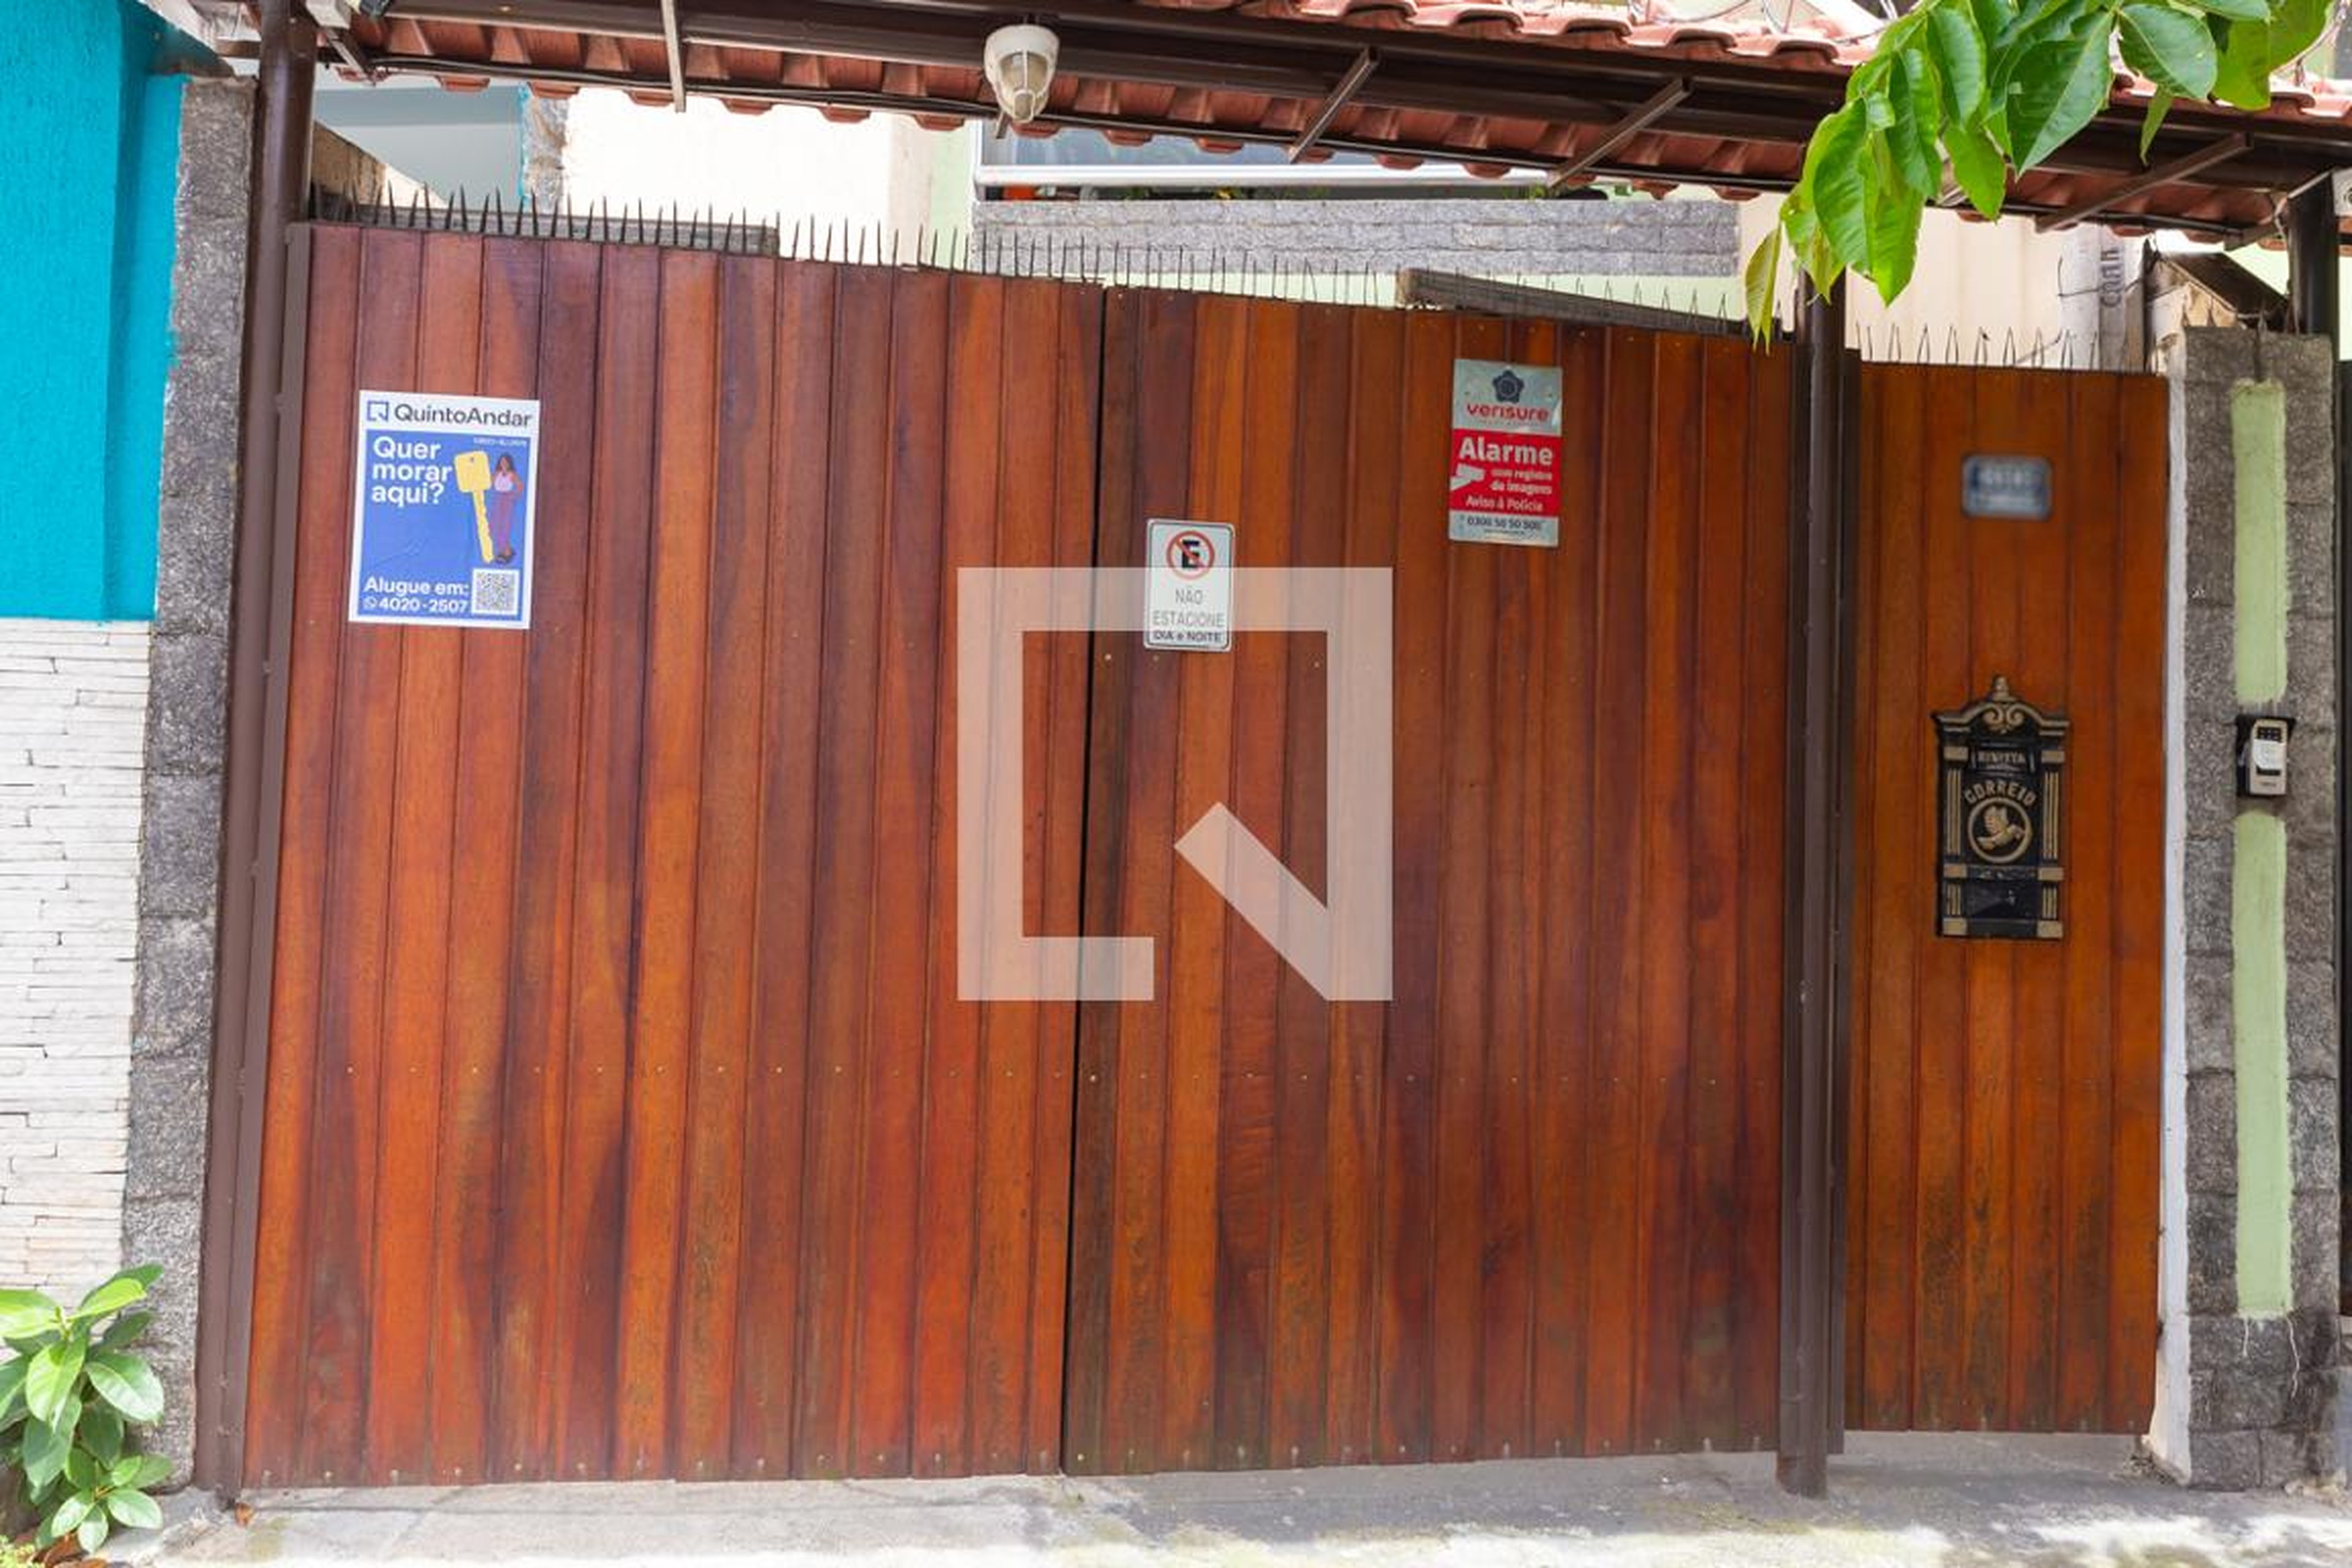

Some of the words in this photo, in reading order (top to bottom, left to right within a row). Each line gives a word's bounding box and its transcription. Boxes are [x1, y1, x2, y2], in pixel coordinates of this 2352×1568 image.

[394, 404, 532, 428] QuintoAndar
[1466, 404, 1550, 422] verisure
[373, 436, 441, 459] Quer
[1458, 437, 1553, 466] Alarme
[372, 463, 453, 482] morar
[371, 483, 445, 507] aqui?
[363, 576, 430, 597] Alugue
[435, 582, 470, 598] em:
[1175, 585, 1204, 605] NÃO
[1152, 611, 1226, 627] ESTACIONE
[1153, 630, 1174, 641] DIA
[1187, 631, 1223, 643] NOITE
[1964, 779, 2037, 807] CORREIO
